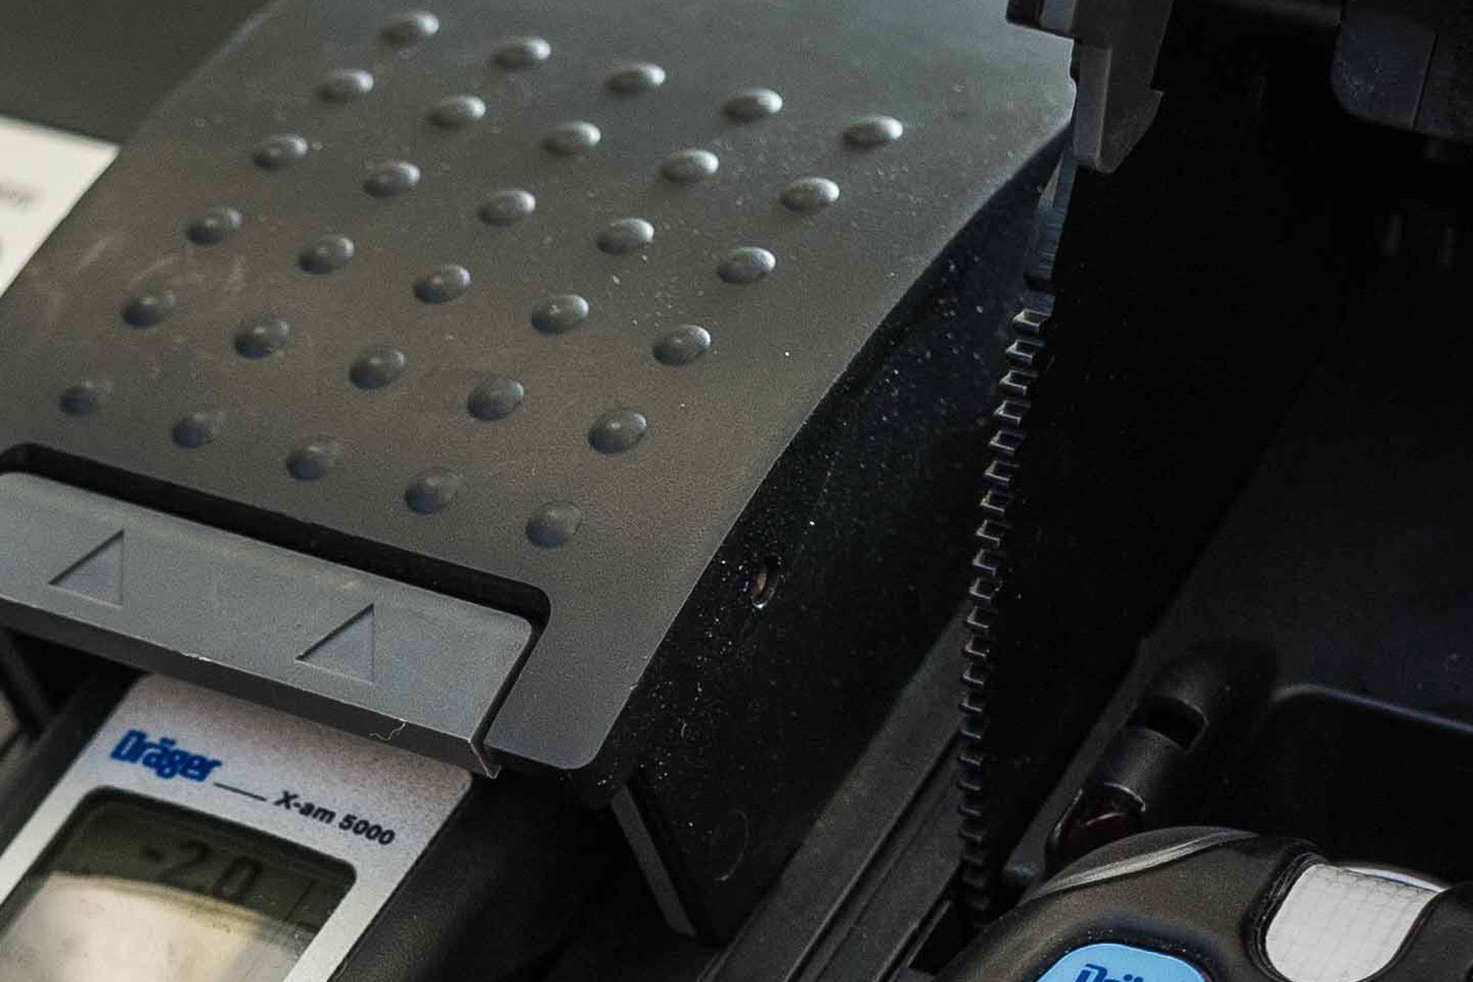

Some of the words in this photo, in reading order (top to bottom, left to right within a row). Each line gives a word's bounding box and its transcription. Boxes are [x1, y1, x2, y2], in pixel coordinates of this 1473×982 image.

[110, 729, 223, 782] Dräger
[274, 790, 336, 825] X-am
[339, 813, 396, 846] 5000
